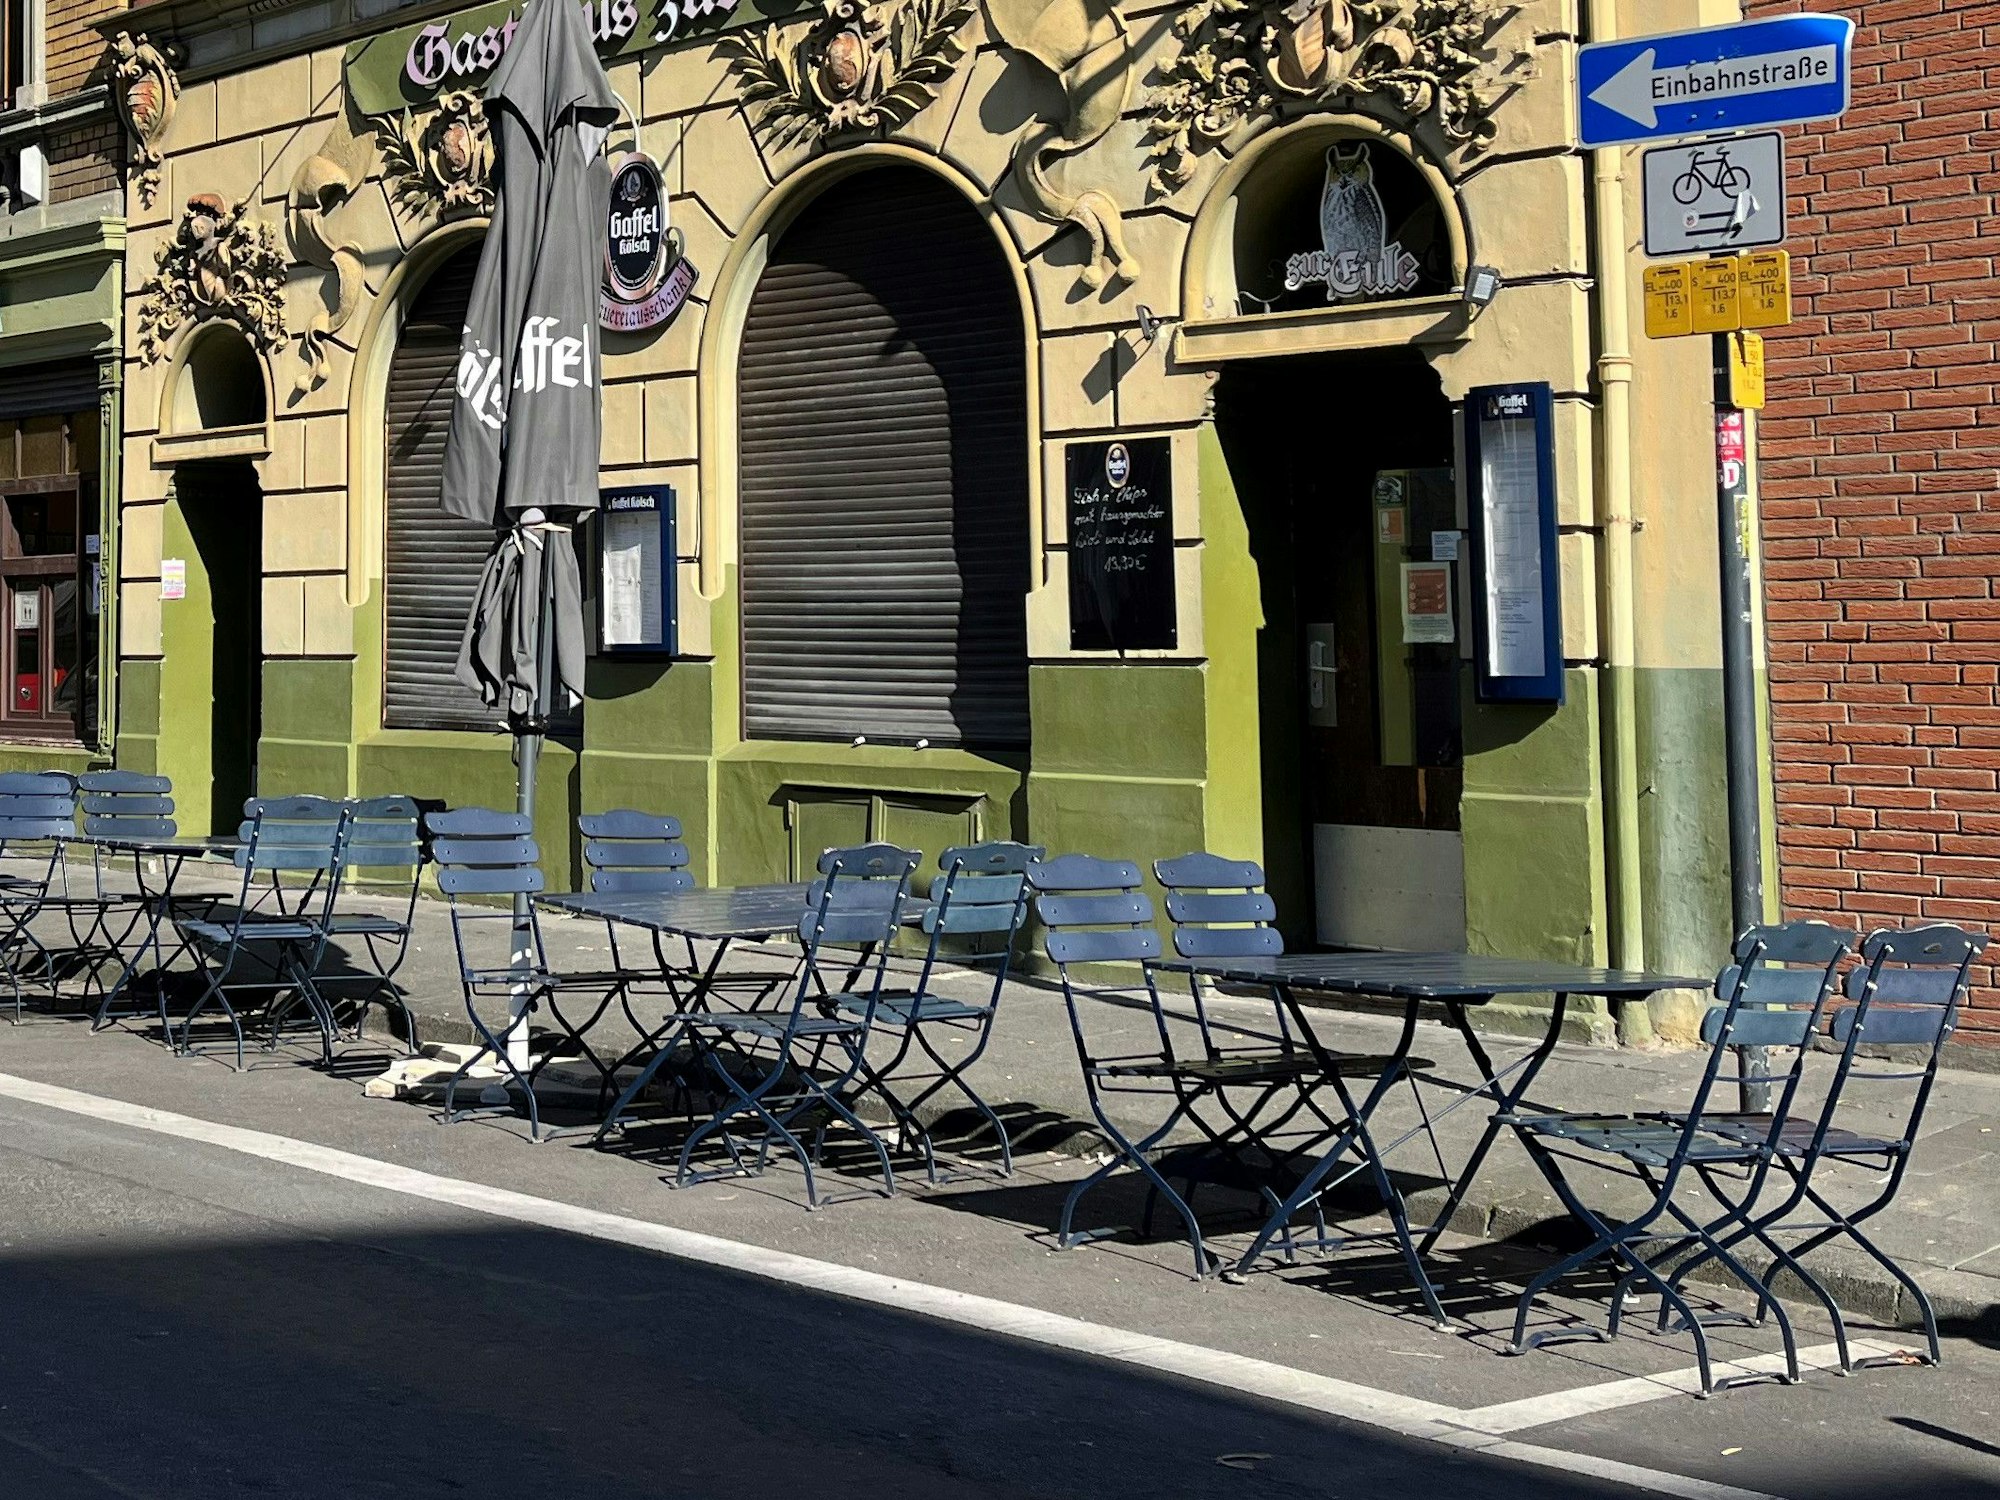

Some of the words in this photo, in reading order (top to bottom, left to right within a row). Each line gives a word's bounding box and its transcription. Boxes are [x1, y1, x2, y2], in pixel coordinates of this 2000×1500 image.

[1652, 56, 1828, 99] Einbahnstraße
[610, 205, 660, 239] Gaffel
[619, 235, 651, 255] Kölsch
[1284, 250, 1333, 291] zur
[1327, 241, 1421, 301] Eule
[1717, 288, 1737, 300] 13.7
[1712, 303, 1726, 315] 1.6
[1761, 298, 1775, 309] 1.6
[1665, 308, 1678, 319] 1.6
[512, 316, 593, 394] ffel
[1074, 487, 1100, 504] Fish
[1105, 531, 1126, 545] und
